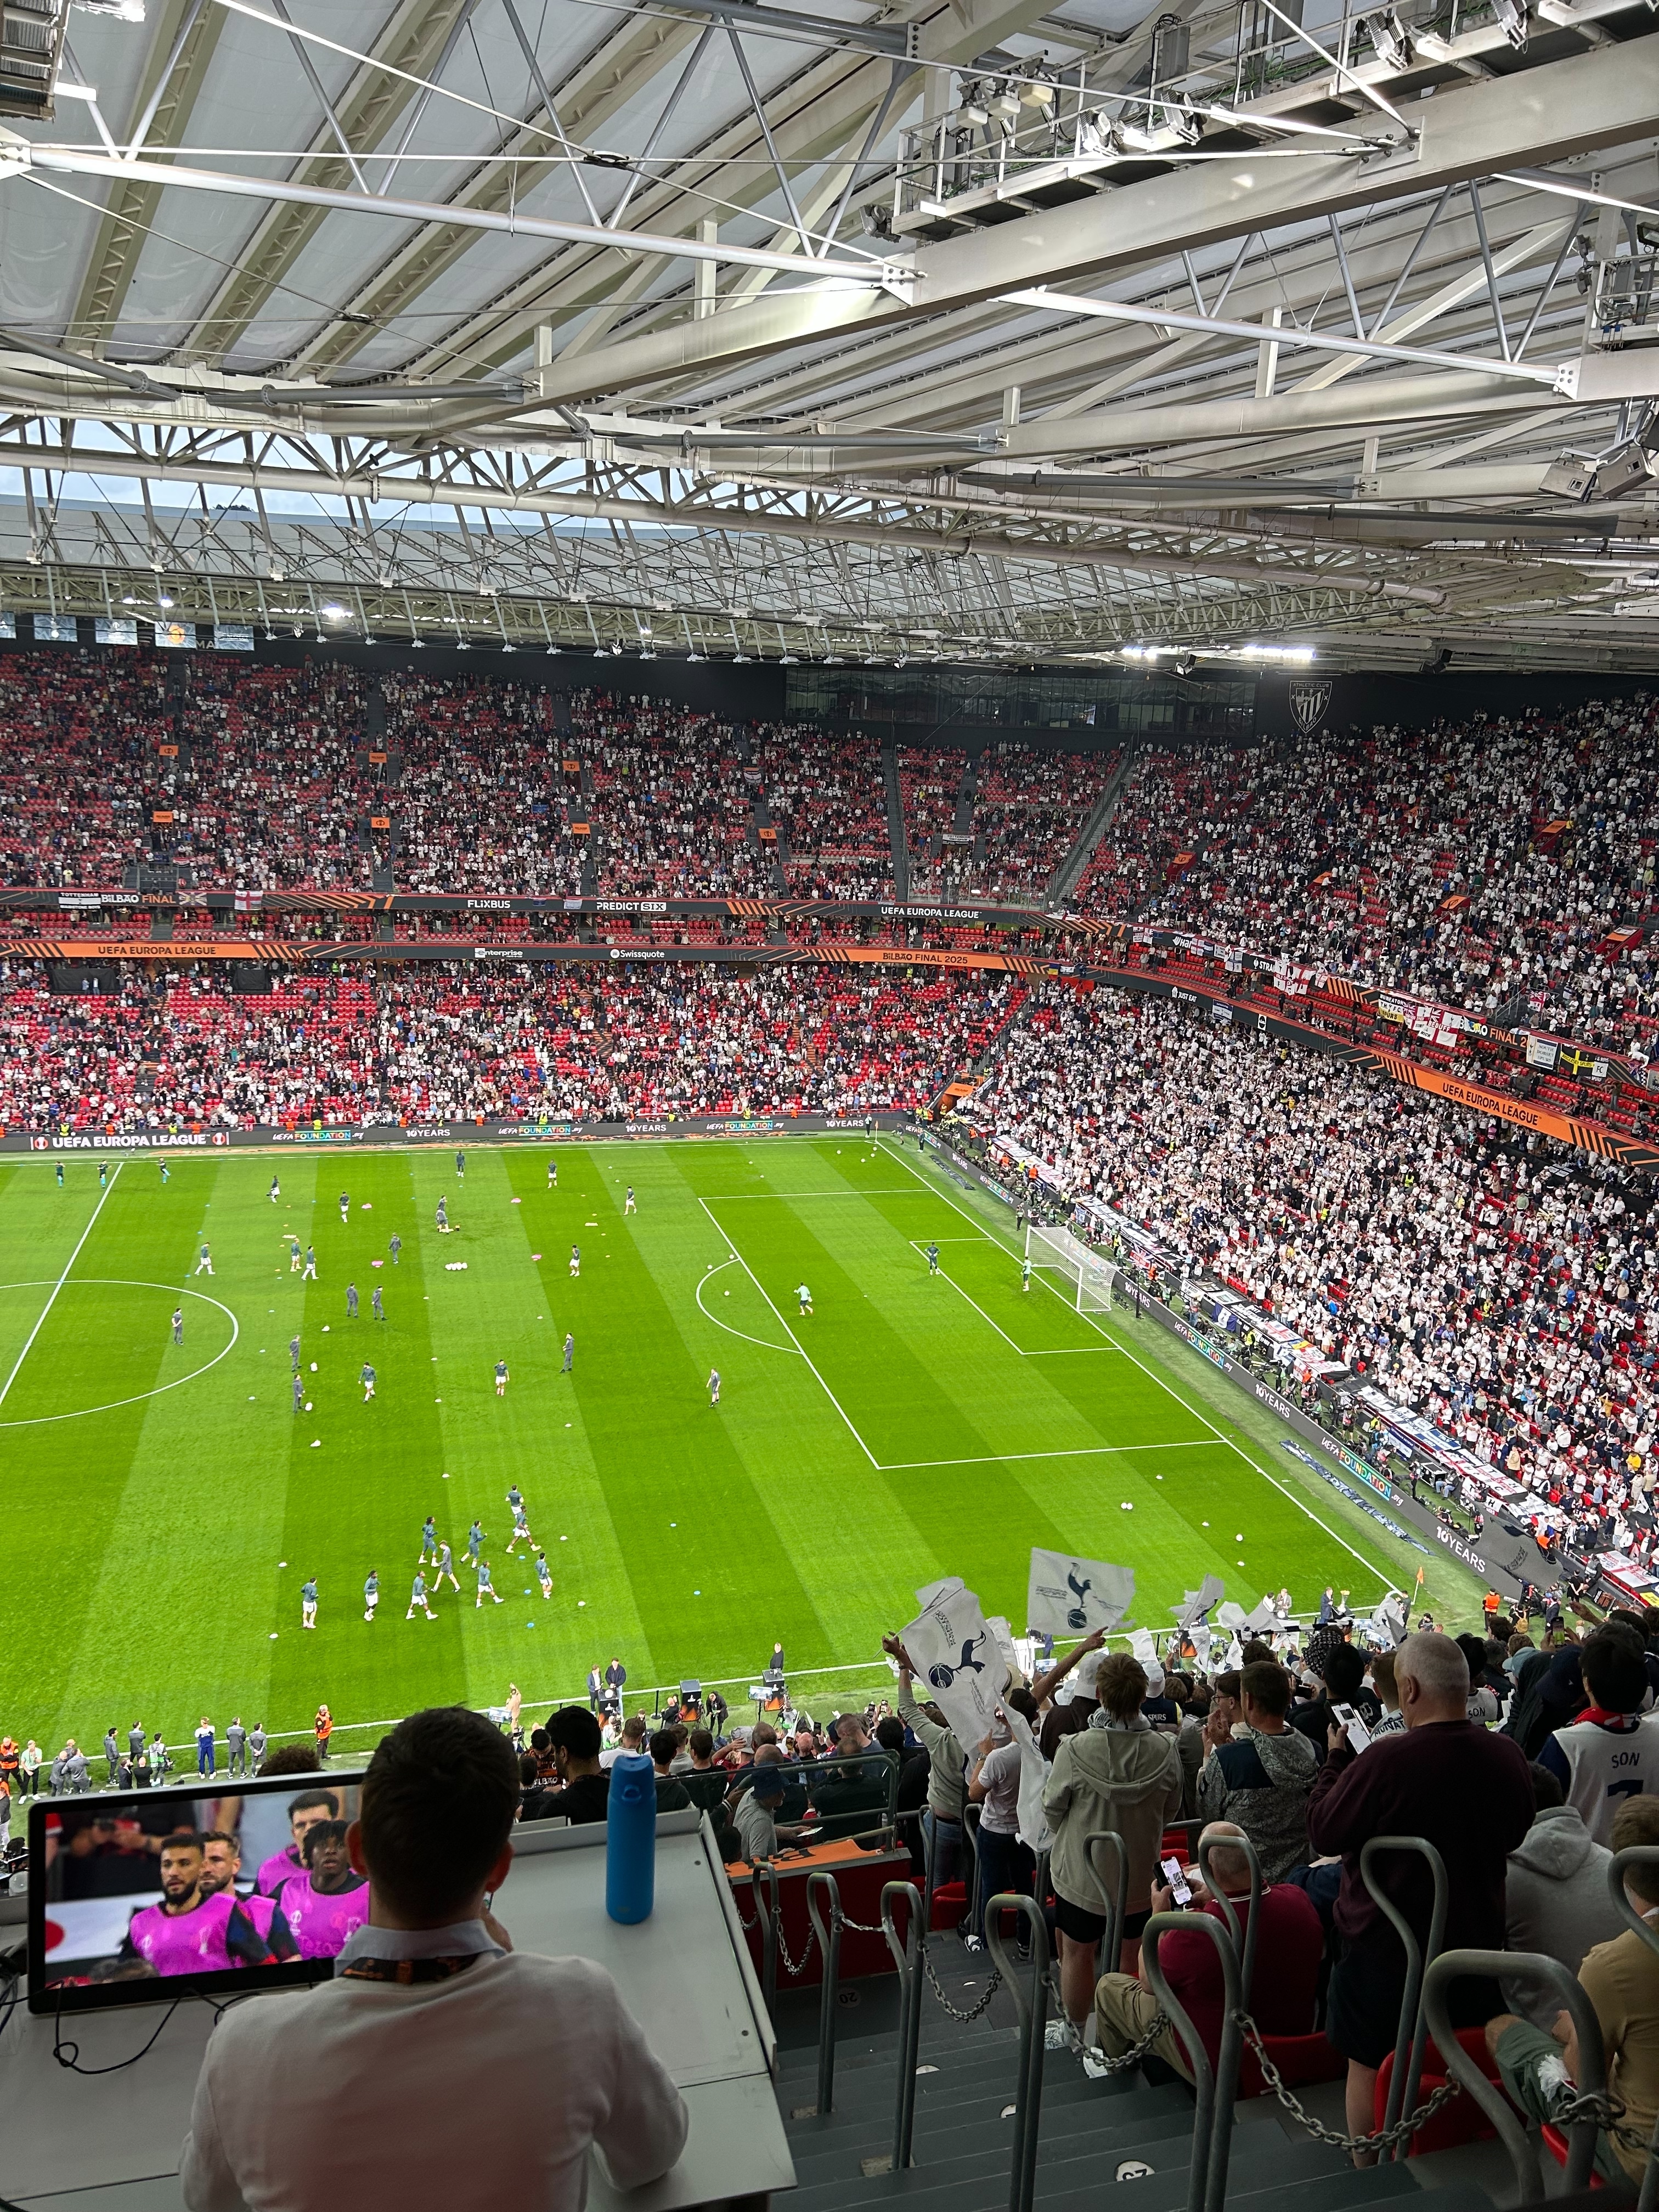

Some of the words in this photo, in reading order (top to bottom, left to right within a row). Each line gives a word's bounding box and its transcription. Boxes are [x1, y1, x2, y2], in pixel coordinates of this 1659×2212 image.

[1299, 716, 1317, 731] BILBAO
[142, 895, 177, 904] FINAL
[596, 901, 640, 911] PREDICT
[642, 902, 665, 911] SIX
[881, 906, 905, 916] UEFA
[906, 907, 943, 917] EUROPA
[944, 909, 979, 919] LEAGUE
[98, 946, 127, 955] UEFA
[129, 946, 172, 955] EUROPA
[620, 950, 665, 959] Swissquote
[915, 953, 943, 963] FINAL
[945, 955, 968, 964] 2025
[1178, 991, 1188, 1001] JUST
[1188, 994, 1198, 1003] EAT
[1489, 1028, 1518, 1046] FINAL
[1562, 1054, 1578, 1065] ANGLESEY
[1596, 1065, 1604, 1074] FC
[1442, 1082, 1464, 1098] UEFA
[1466, 1090, 1500, 1113] EUROPA
[1502, 1104, 1539, 1126] LEAGUE
[52, 1137, 91, 1148] UEFA
[93, 1135, 150, 1147] EUROPA
[152, 1134, 207, 1146] LEAGUE
[273, 1133, 293, 1141] UEFA
[1174, 1321, 1188, 1337] UEFA
[1187, 1331, 1224, 1366] FOUNDATION
[1321, 1436, 1340, 1457] UEFA
[1340, 1451, 1392, 1500] FOUNDATION
[1468, 1707, 1486, 1719] SON
[1611, 1752, 1640, 1769] SON
[839, 1992, 858, 2004] 20
